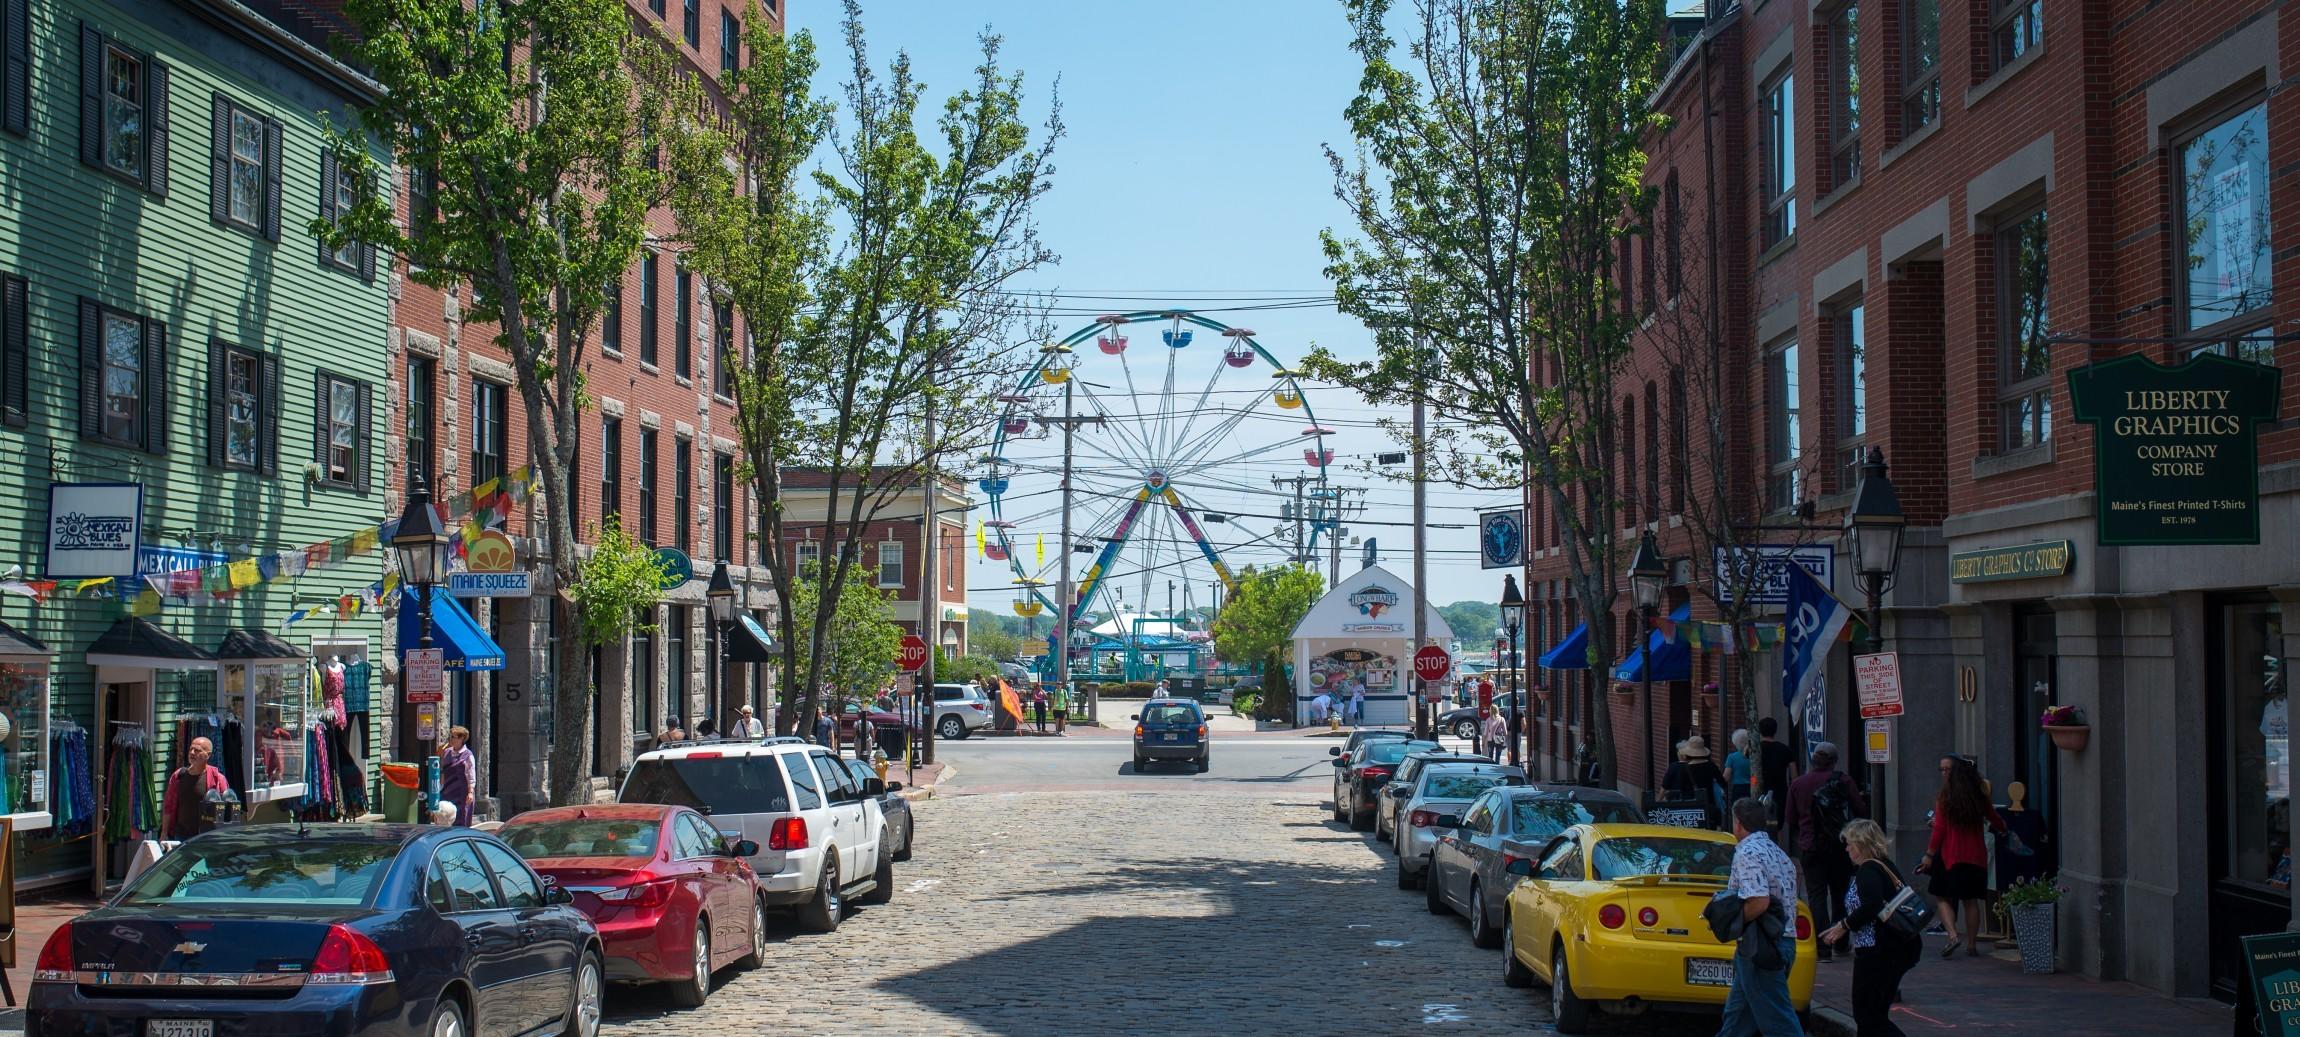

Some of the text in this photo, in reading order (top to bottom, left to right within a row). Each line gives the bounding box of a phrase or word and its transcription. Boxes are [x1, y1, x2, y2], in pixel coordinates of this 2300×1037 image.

[2125, 390, 2231, 411] LIBERTY
[2114, 415, 2240, 436] GRAPHICS
[2137, 444, 2218, 459] COMPANY
[2151, 462, 2205, 477] STORE
[2111, 499, 2247, 511] Maine's Finest Printed T-Shirts
[89, 521, 132, 533] MEXICALI
[2161, 516, 2197, 525] EST. 1978
[90, 532, 122, 542] BLUES
[137, 552, 194, 577] MEXICALI
[1952, 556, 1982, 579] LIBERTY
[1983, 551, 2021, 576] GRAPHICS
[2035, 547, 2064, 571] STORE
[452, 574, 527, 590] MAINE SQUEEZE
[442, 657, 465, 668] AFÉ
[1416, 656, 1448, 671] STOP
[1858, 664, 1894, 674] PARKING
[1959, 666, 1976, 701] 10
[507, 683, 520, 702] 5
[1671, 813, 1704, 821] MEXICALI
[2254, 952, 2278, 960] Maine's
[2278, 951, 2297, 959] Finest
[1696, 964, 1719, 978] 2260
